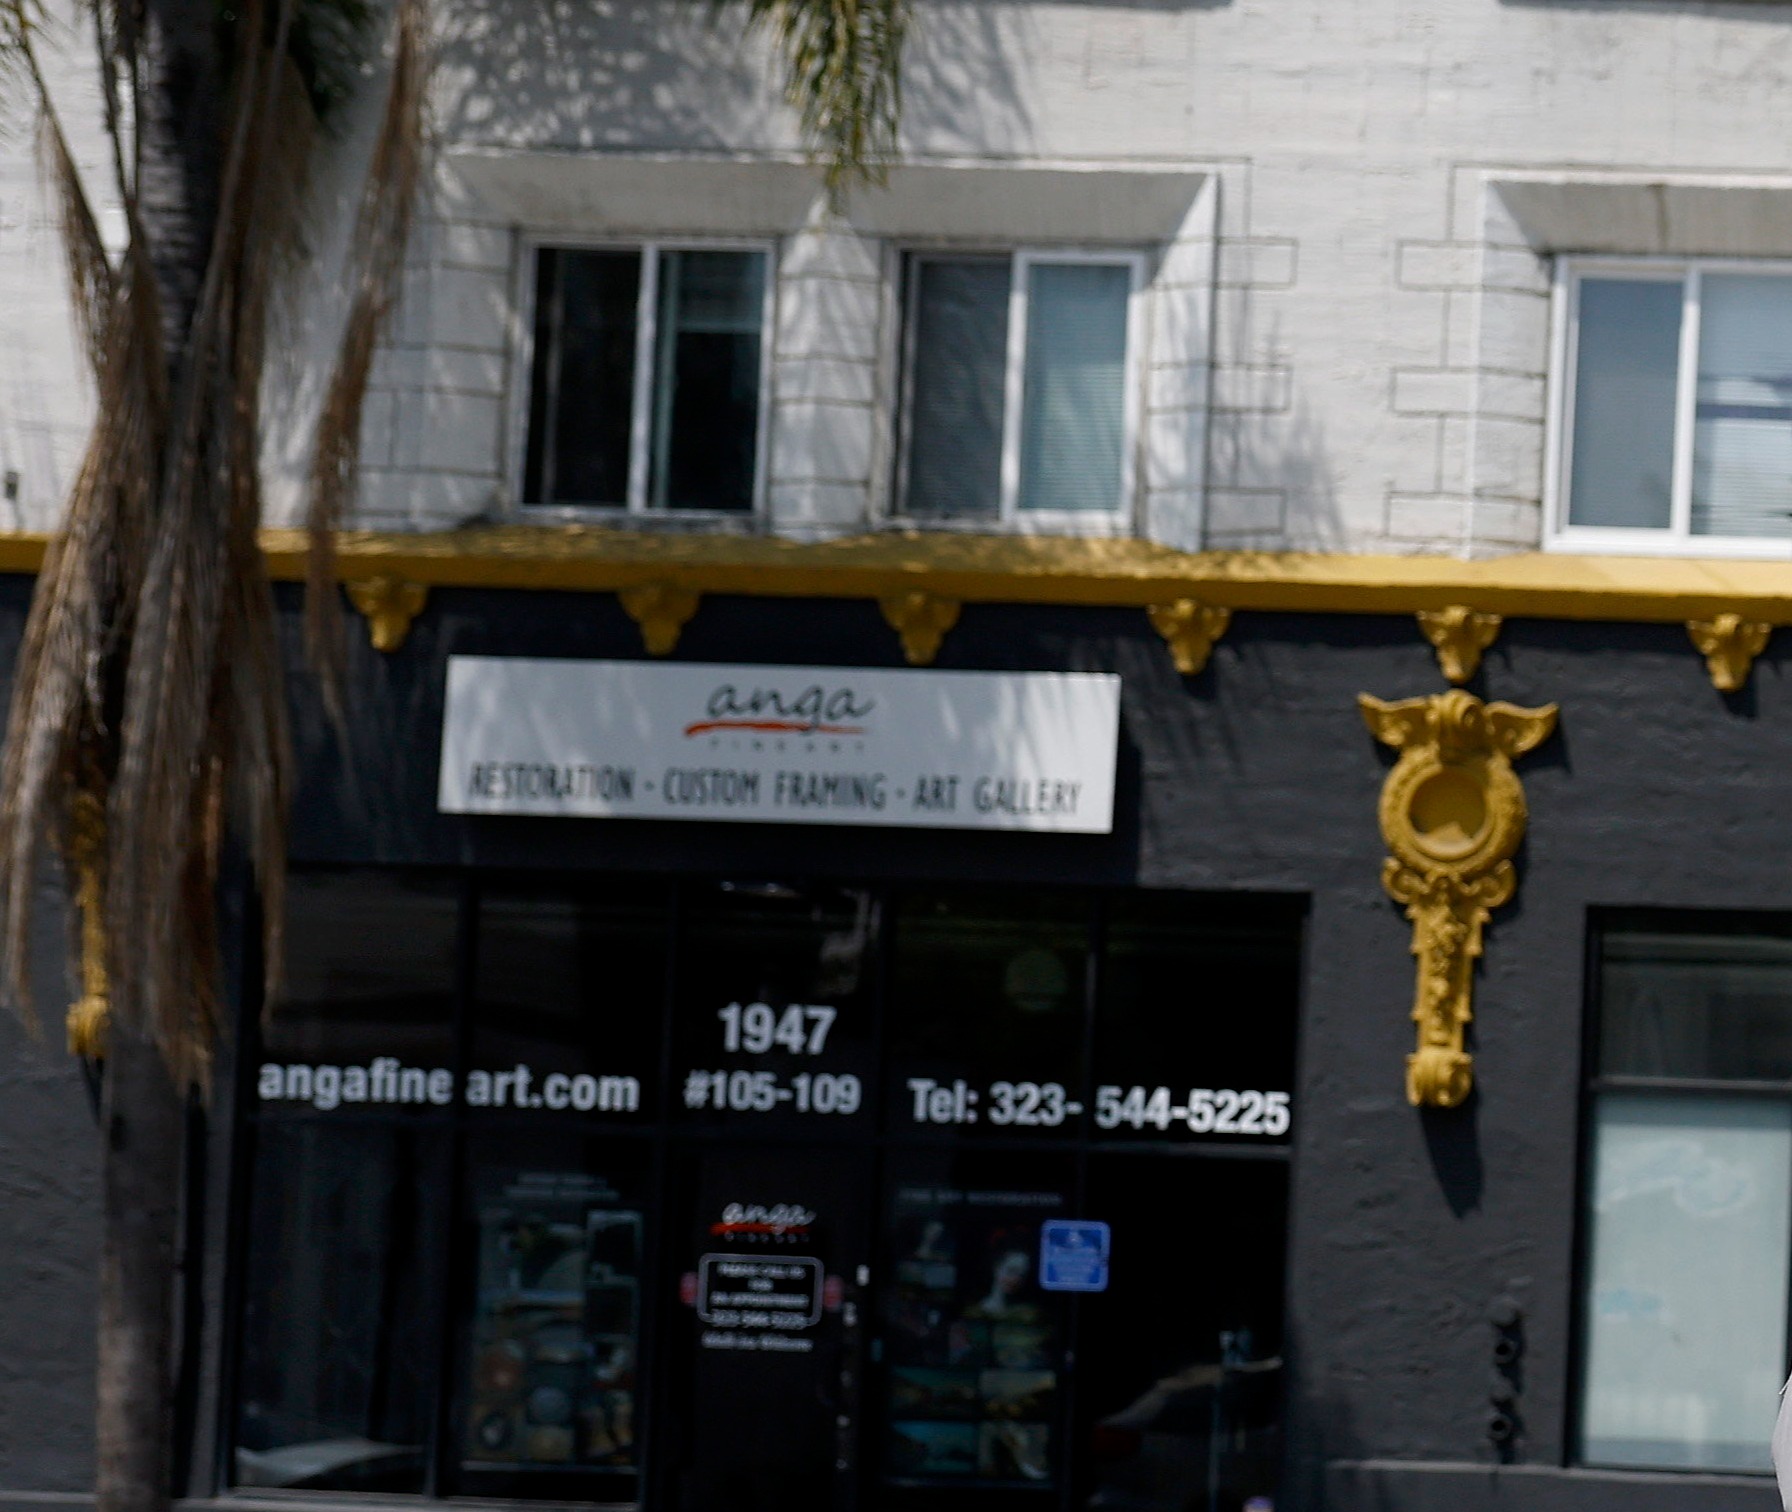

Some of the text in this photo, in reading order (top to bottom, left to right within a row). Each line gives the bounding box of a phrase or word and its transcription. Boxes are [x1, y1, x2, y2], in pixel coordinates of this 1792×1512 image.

[706, 684, 877, 736] anga
[470, 761, 1082, 815] RESTORATION CUSTOM FRAMING ART GALLERY
[718, 1002, 837, 1056] 1947
[683, 1069, 862, 1115] #105-109
[907, 1079, 978, 1123] Tel:
